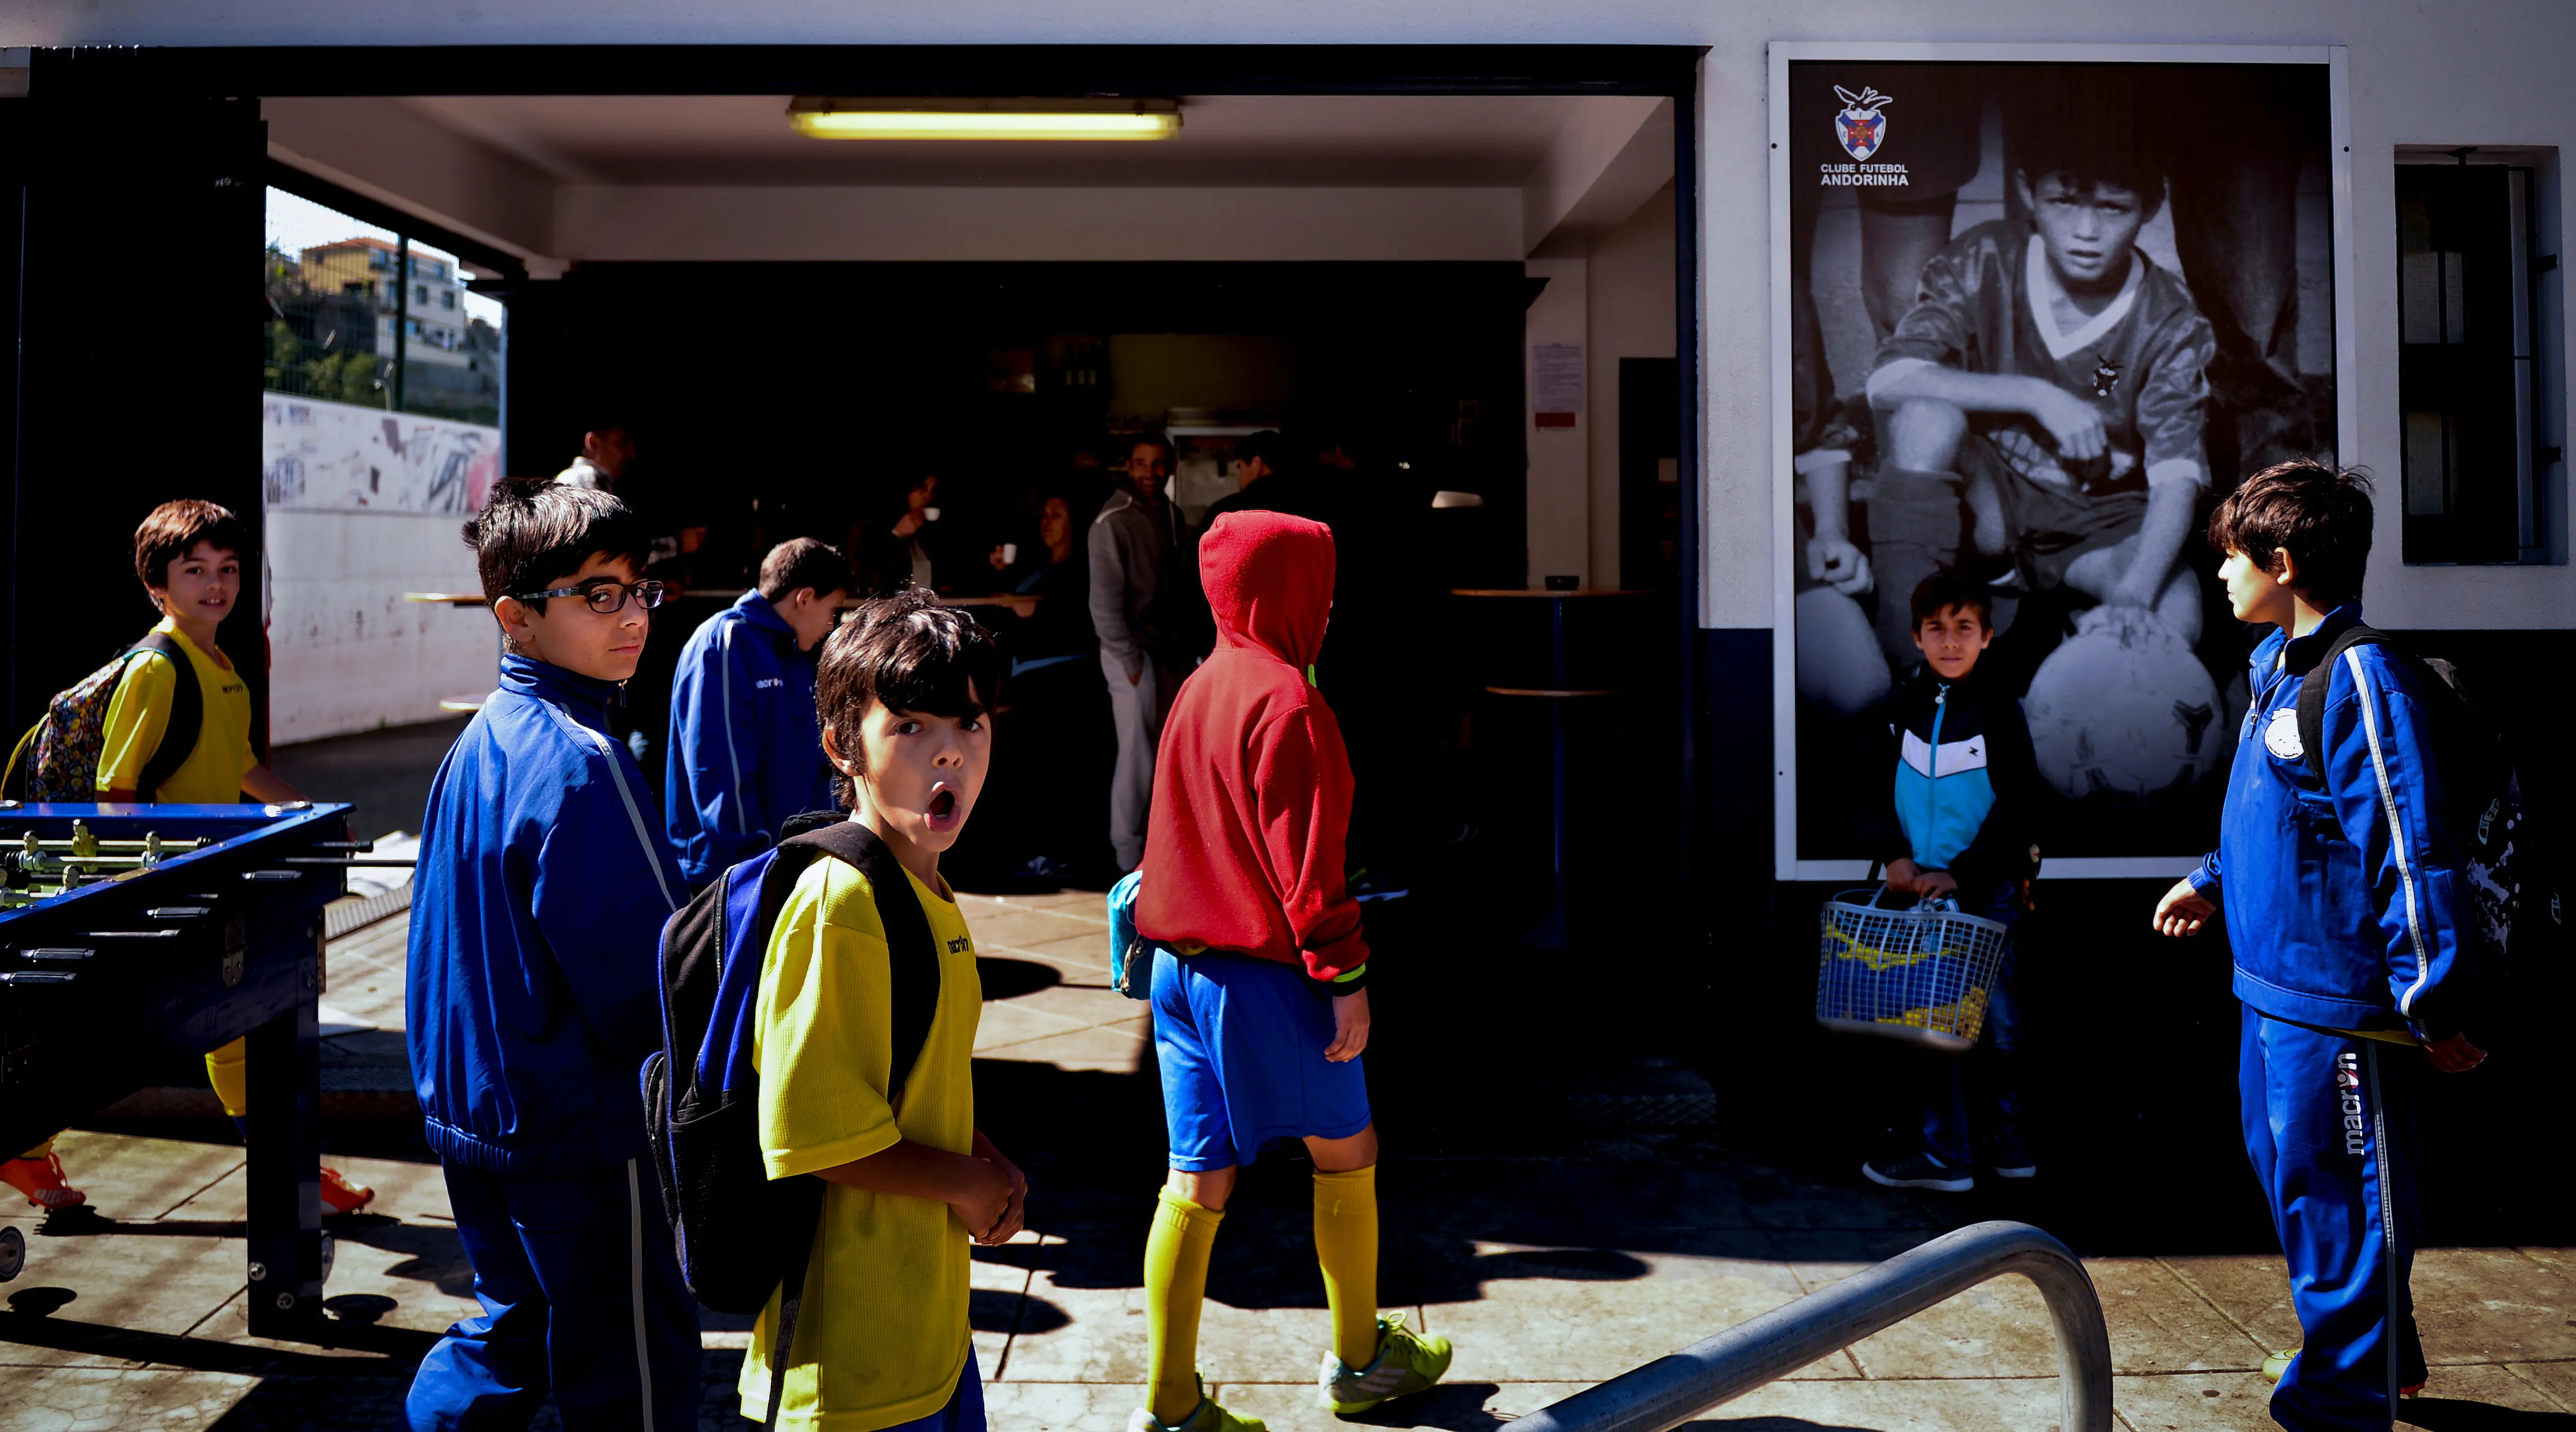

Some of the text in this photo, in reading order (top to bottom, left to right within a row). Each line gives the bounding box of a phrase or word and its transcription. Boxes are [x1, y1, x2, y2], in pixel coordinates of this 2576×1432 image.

[1821, 164, 1908, 173] CLUBE FUTEBOL
[1821, 174, 1909, 186] ANDORINHA
[2336, 1053, 2365, 1155] macron
